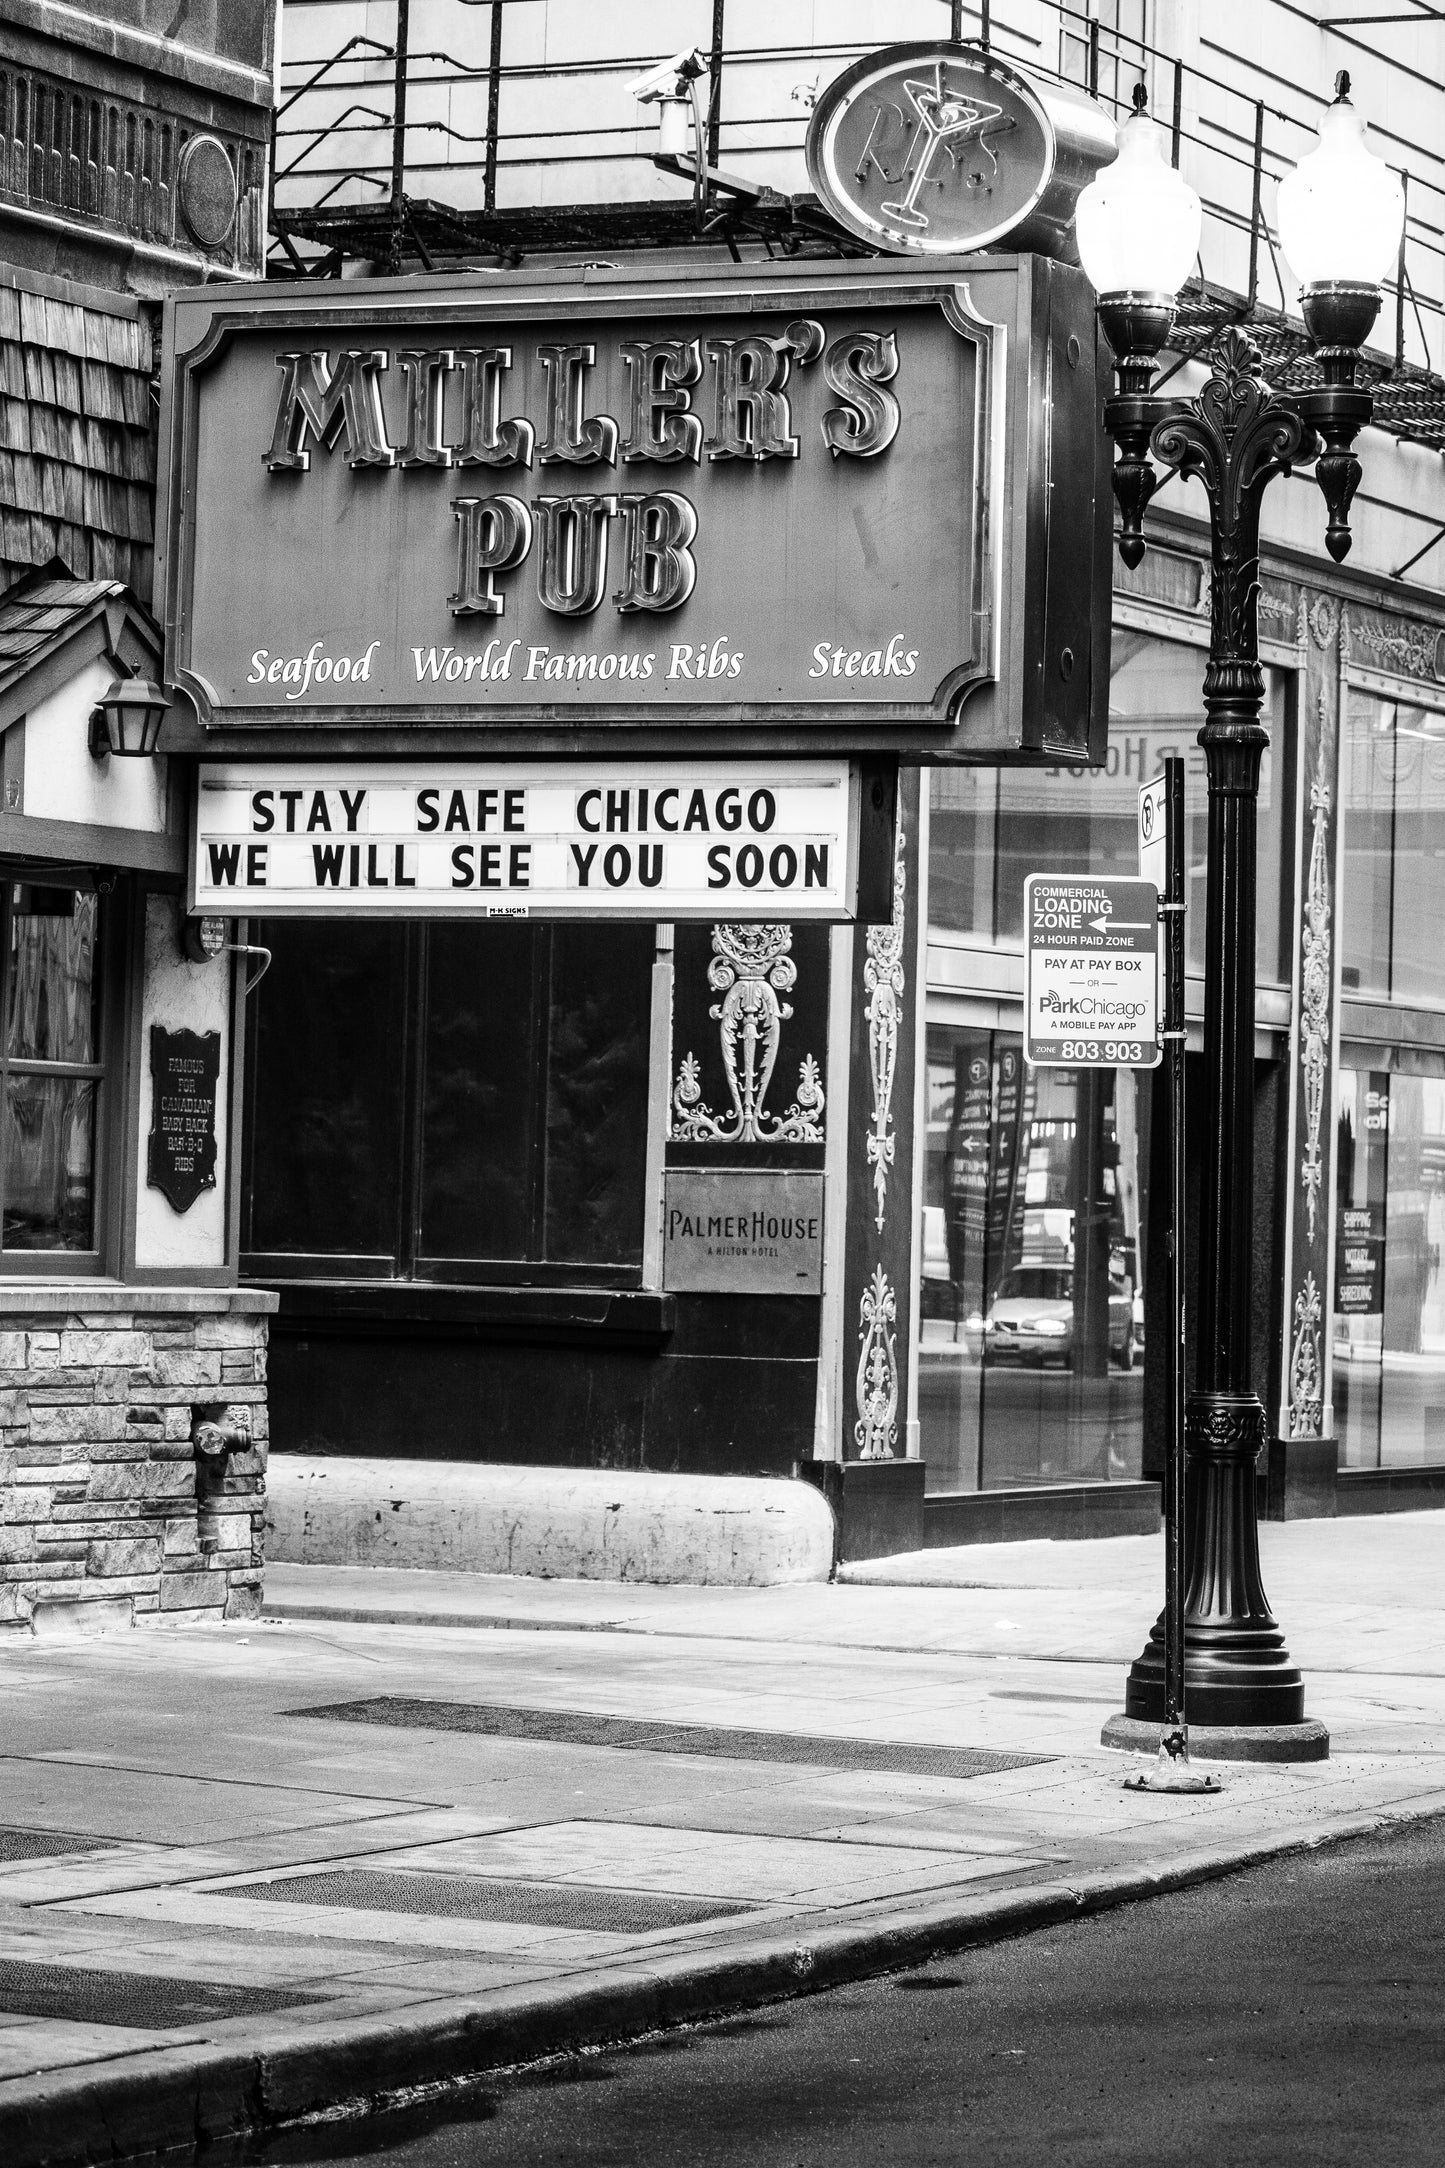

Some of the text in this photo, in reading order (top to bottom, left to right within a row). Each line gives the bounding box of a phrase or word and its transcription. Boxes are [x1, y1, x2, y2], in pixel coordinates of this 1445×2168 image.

[261, 320, 902, 473] MILLER'S
[447, 491, 698, 617] PUB
[411, 635, 744, 682] World Famous Ribs
[808, 633, 920, 678] Steaks
[246, 640, 381, 700] Seafood
[252, 788, 776, 833] STAY SAFE CHICAGO
[208, 843, 829, 888] WE WILL SEE YOU SOON
[1033, 887, 1109, 899] COMMERCIAL
[1034, 898, 1113, 914] LOADING
[1033, 913, 1082, 929] ZONE
[1033, 935, 1135, 947] 24 HOUR PAID ZONE
[1044, 958, 1142, 971] PAY AT PAY BOX
[1087, 979, 1100, 987] OR
[1039, 996, 1146, 1019] ParkChicago
[1050, 1021, 1137, 1031] A MOBILE PAY APP
[1035, 1046, 1056, 1054] ZONE
[168, 1058, 204, 1074] FAMOUS
[178, 1078, 196, 1093] FOR
[161, 1096, 210, 1113] CANADIAN
[162, 1116, 208, 1133] BABY BACK
[174, 1156, 194, 1172] RIBS
[716, 1247, 748, 1256] HILTON
[751, 1247, 778, 1257] HOTEL
